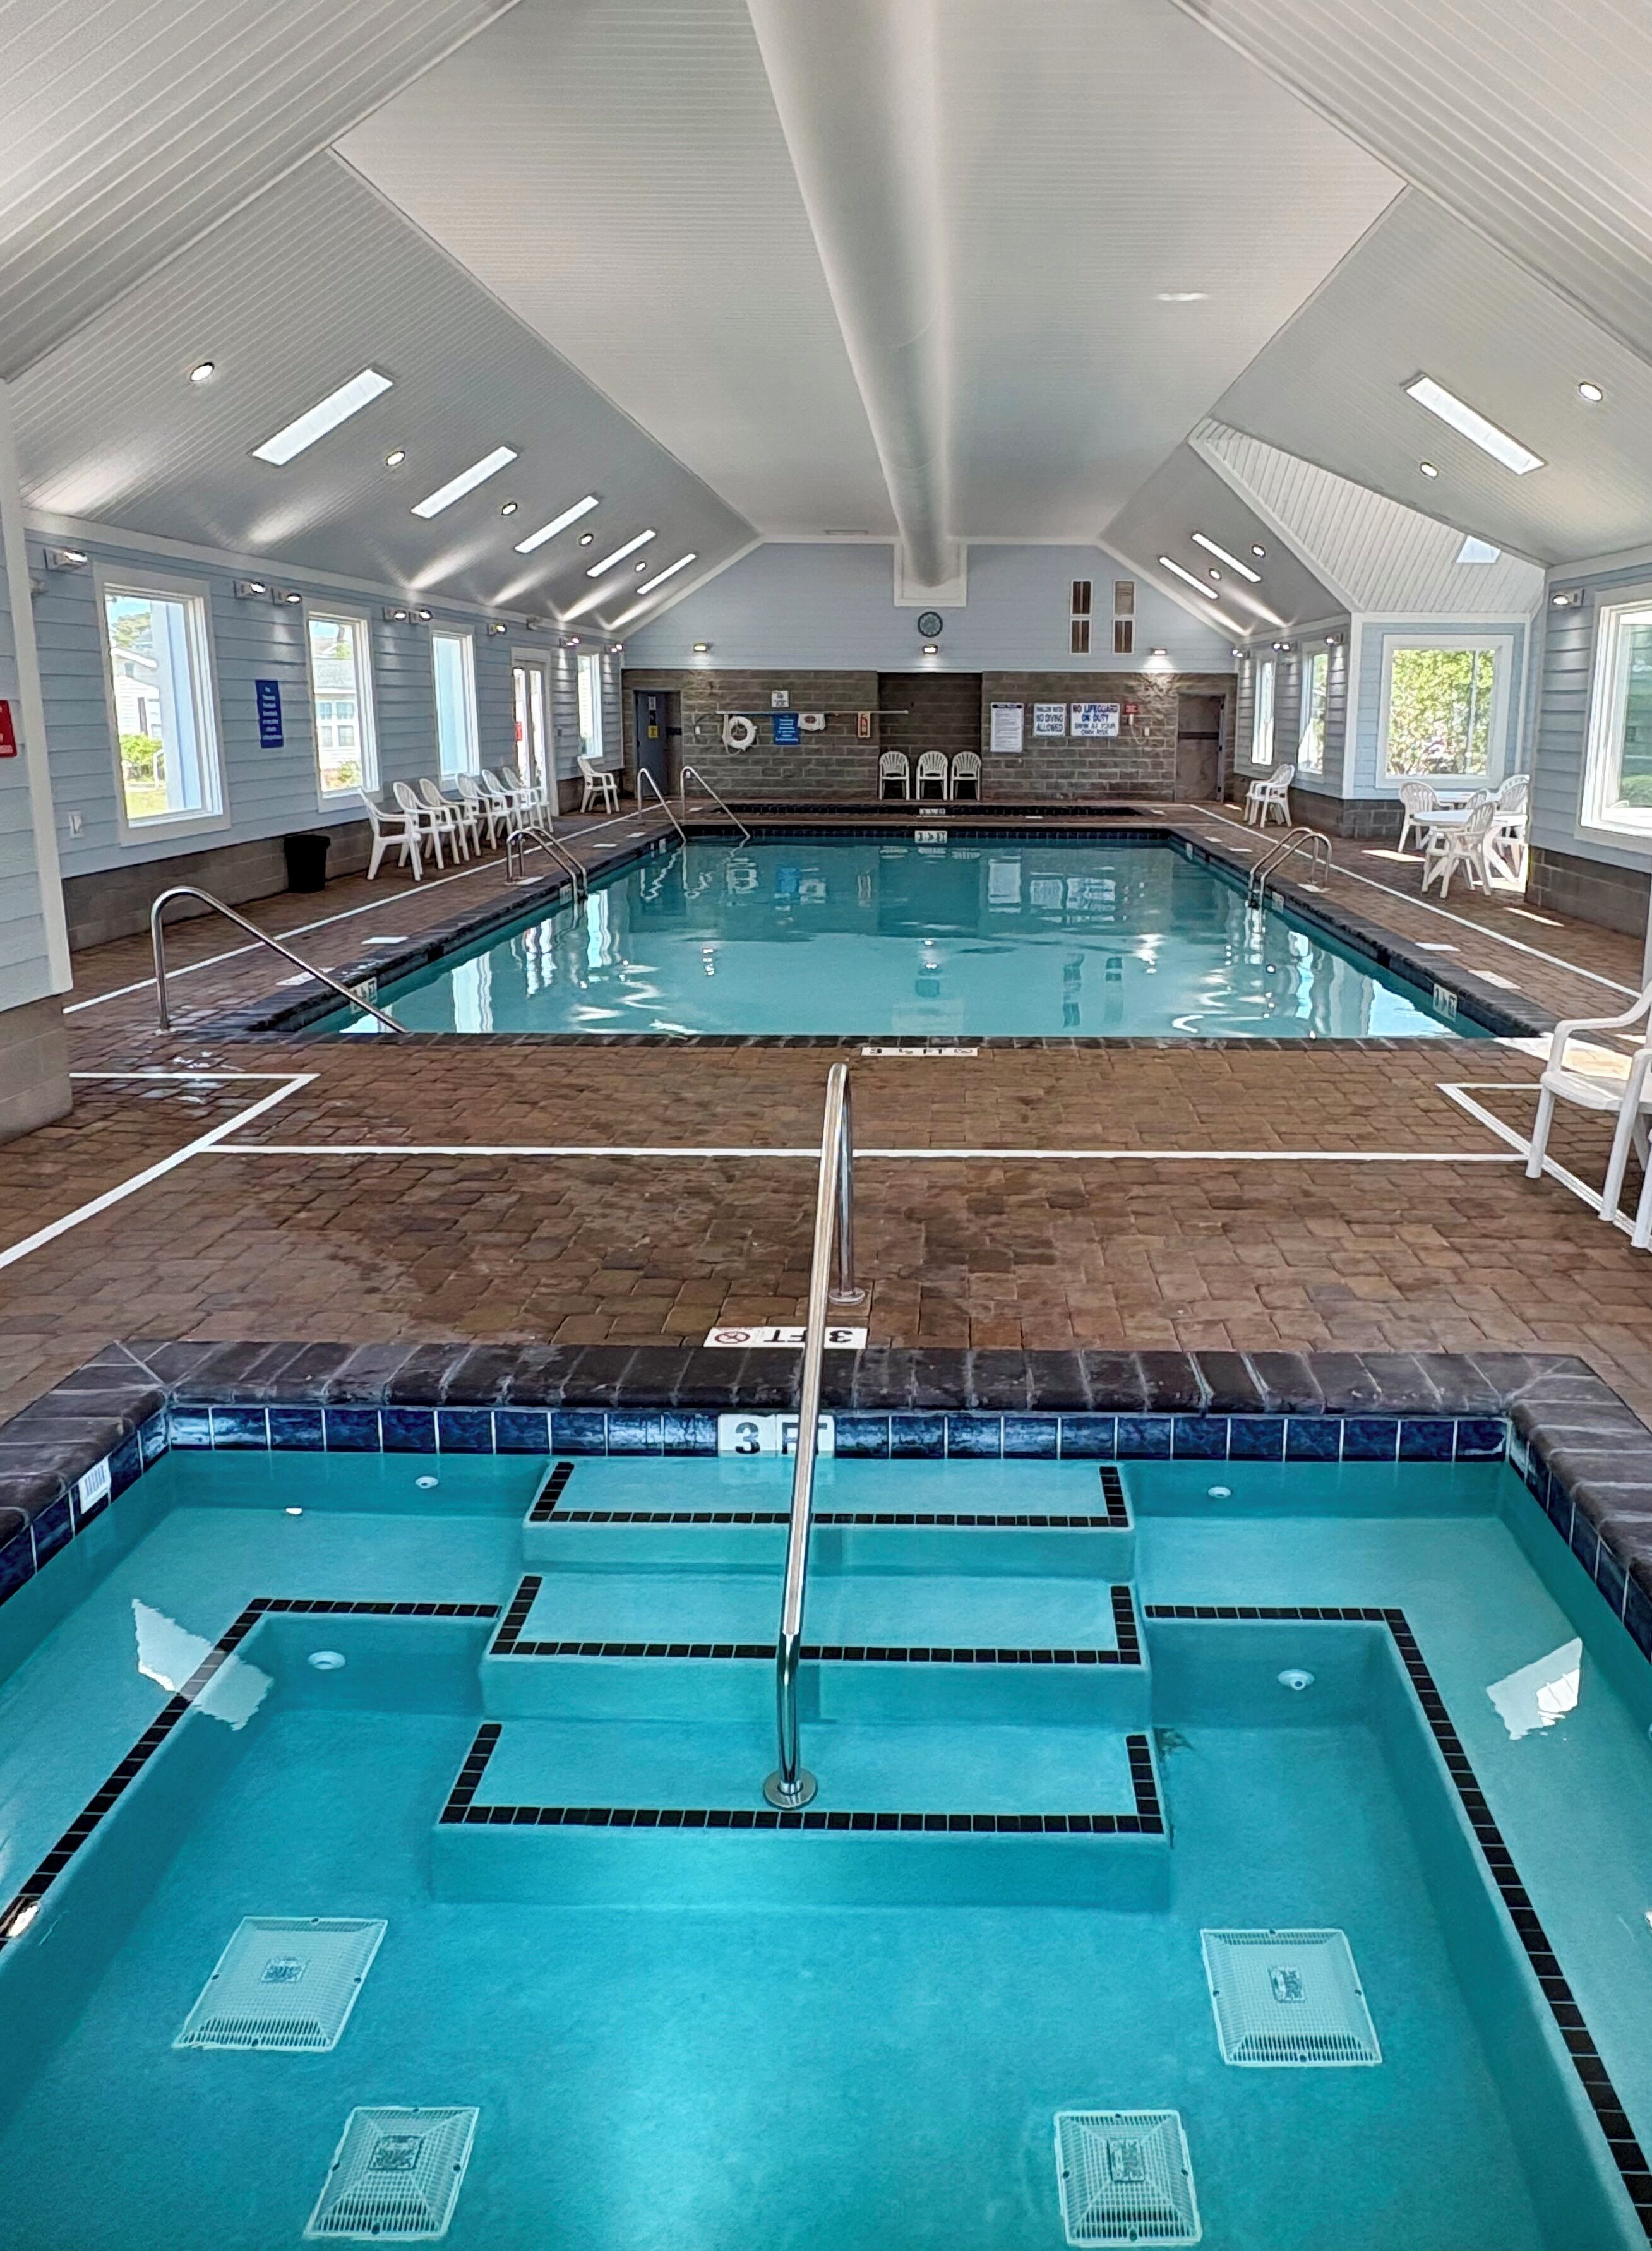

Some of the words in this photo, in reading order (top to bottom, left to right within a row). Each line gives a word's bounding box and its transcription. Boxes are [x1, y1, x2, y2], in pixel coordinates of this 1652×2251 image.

[1073, 705, 1082, 713] NO
[1084, 705, 1118, 713] LIFEGUARD
[1036, 714, 1044, 722] NO
[1045, 714, 1063, 722] DIVING
[1082, 713, 1090, 722] ON
[1093, 713, 1109, 722] DUTY
[1036, 723, 1063, 732] ALLOWED
[829, 1330, 853, 1343] 3
[735, 1421, 760, 1454] 3
